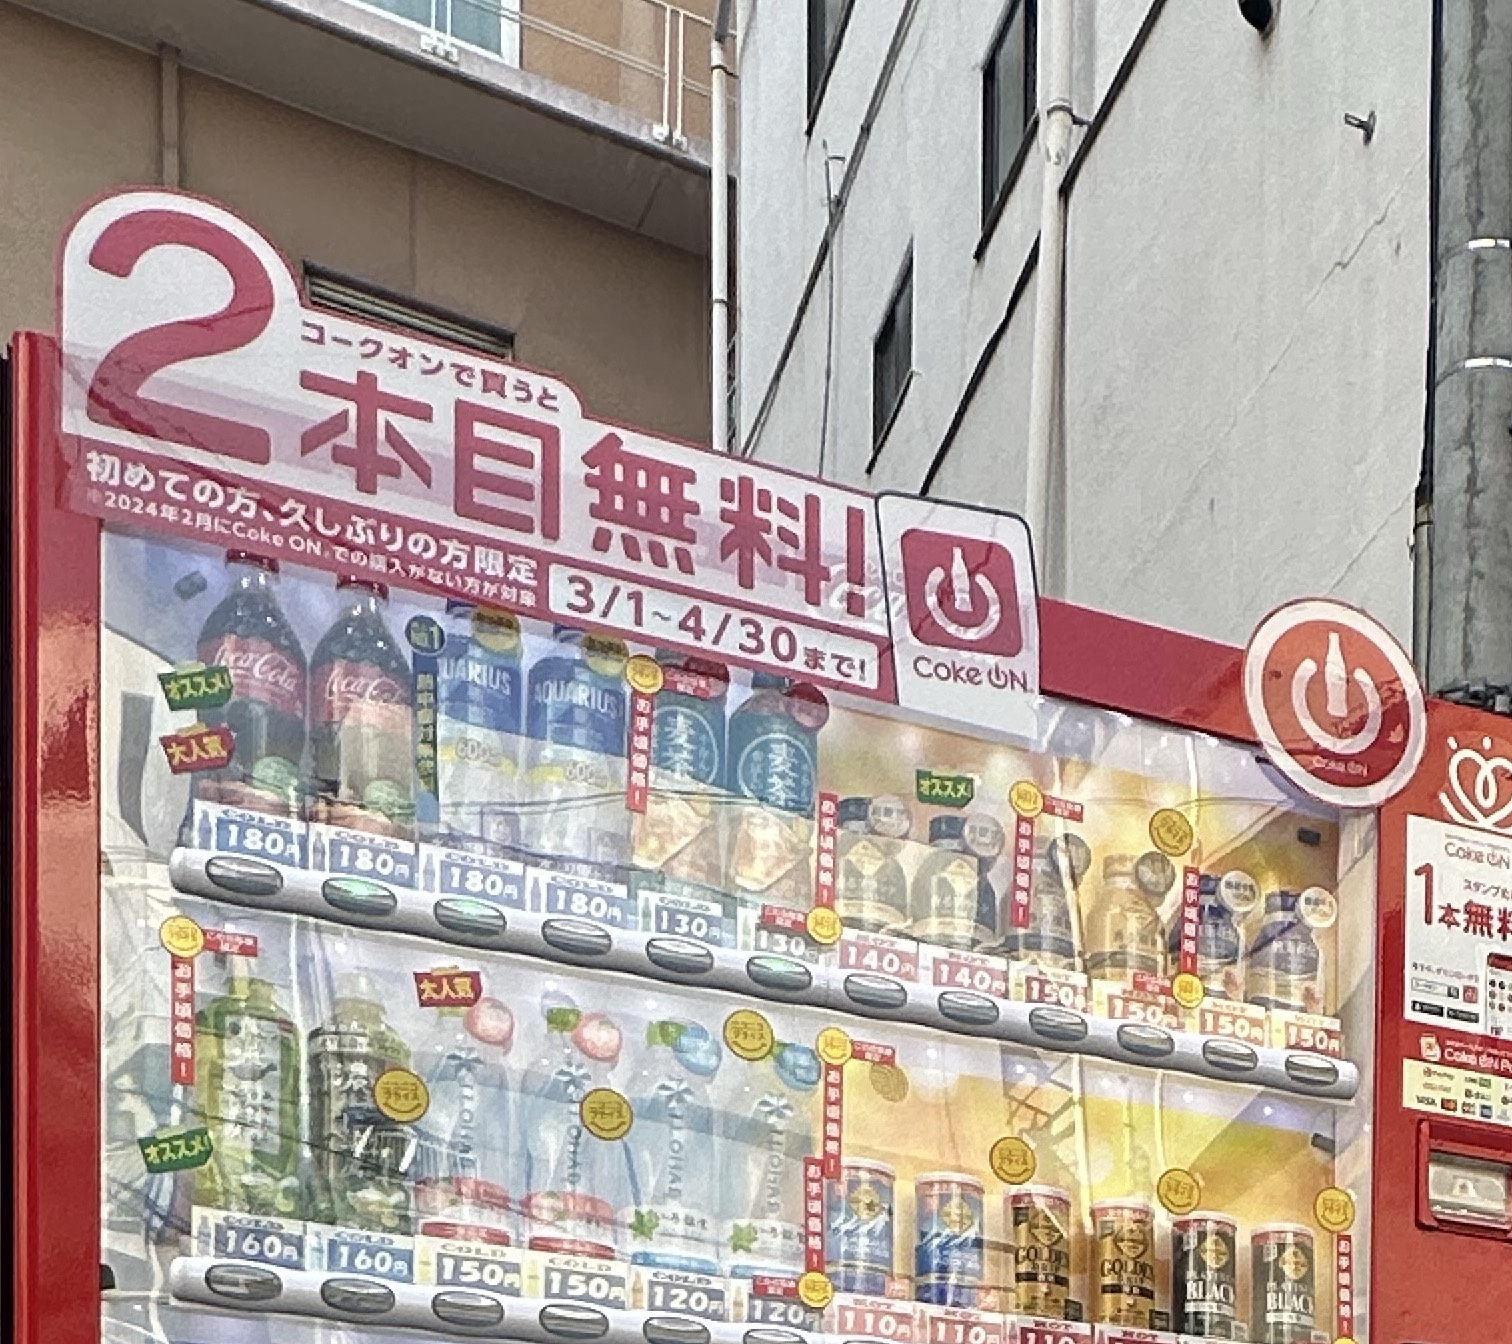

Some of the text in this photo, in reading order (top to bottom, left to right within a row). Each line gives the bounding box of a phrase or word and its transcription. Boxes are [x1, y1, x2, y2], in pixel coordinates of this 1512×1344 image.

[301, 320, 560, 411] コークオンで買うと
[85, 450, 539, 586] 初めての方、久しぶりの方限定
[913, 655, 982, 686] Coke
[228, 823, 299, 857] 180円
[341, 844, 411, 880] 180円
[451, 866, 518, 899] 180円
[556, 890, 621, 918] 180円
[225, 1232, 297, 1260] 160円
[338, 1246, 408, 1274] 160円
[442, 1259, 519, 1289] 150円
[549, 1273, 624, 1301] 150円
[652, 1287, 723, 1313] 120円
